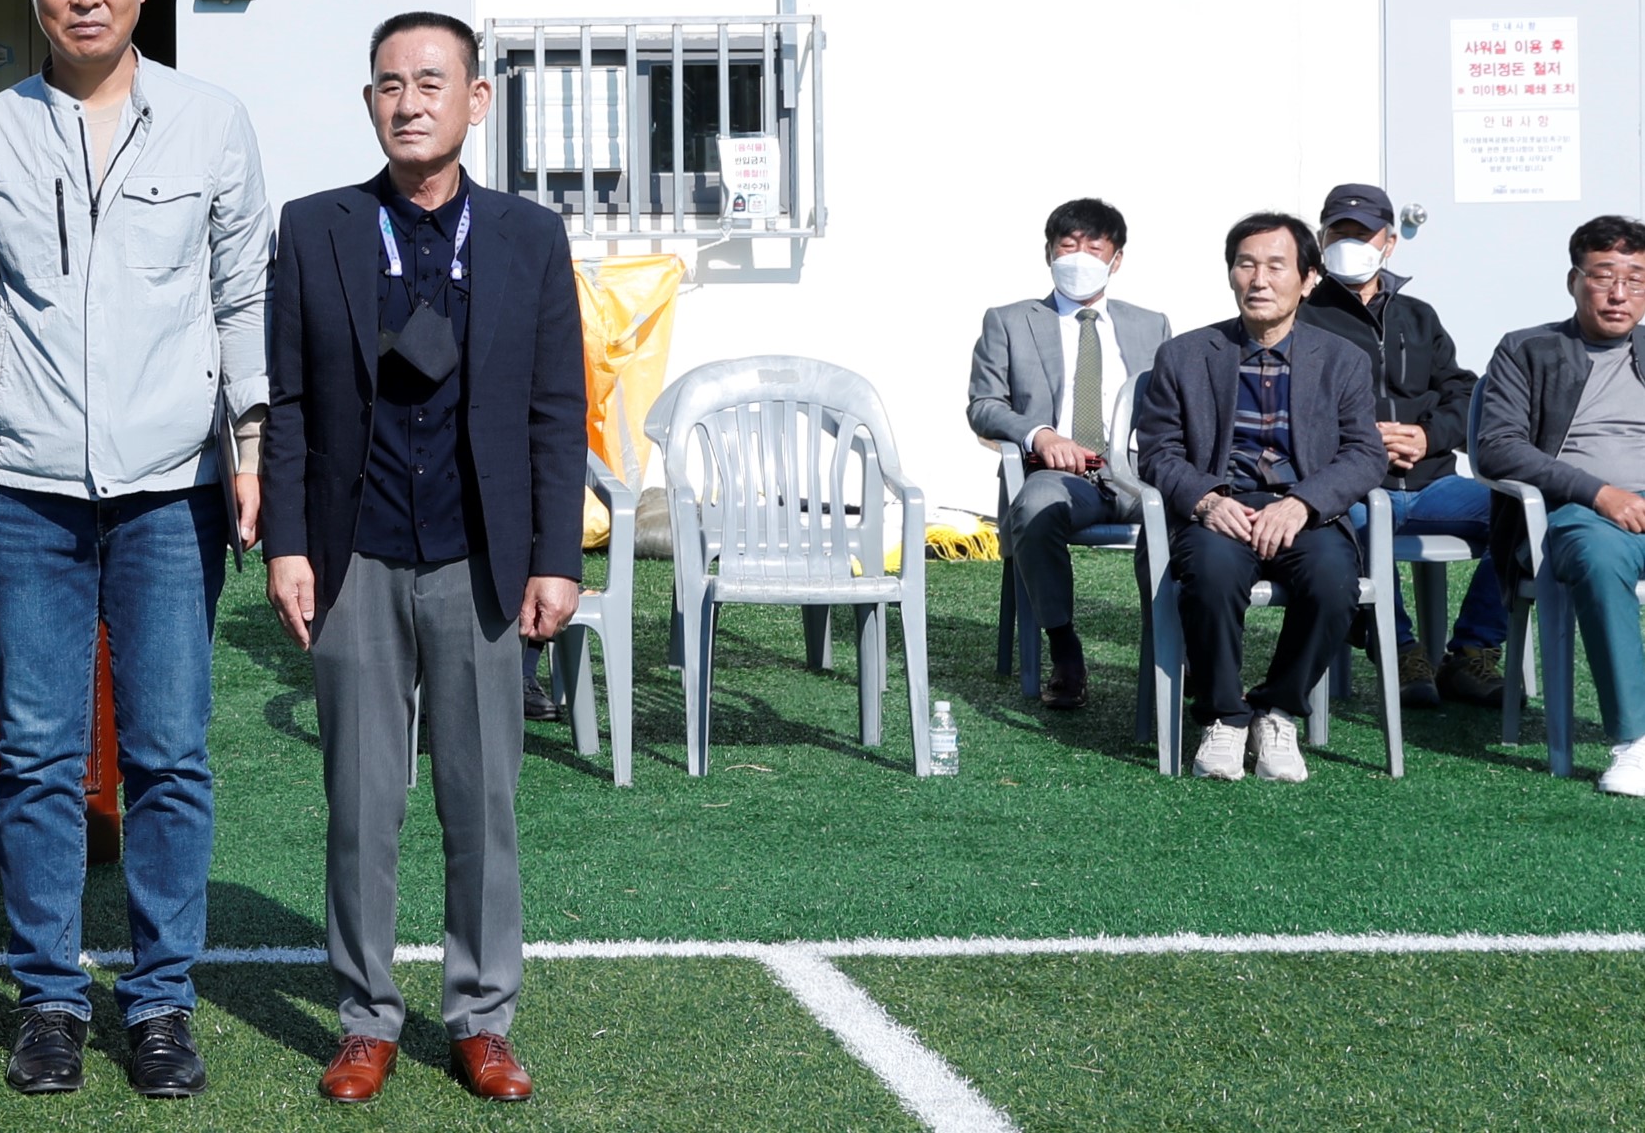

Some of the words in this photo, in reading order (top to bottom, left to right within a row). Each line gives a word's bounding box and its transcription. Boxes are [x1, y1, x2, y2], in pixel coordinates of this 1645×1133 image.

[1464, 40, 1507, 56] 샤워실
[1514, 39, 1543, 55] 이용
[1550, 38, 1565, 54] 후
[1468, 62, 1525, 77] 정리정돈
[1533, 61, 1562, 76] 철저
[1472, 84, 1518, 97] 미이행시
[1552, 82, 1576, 96] 조치
